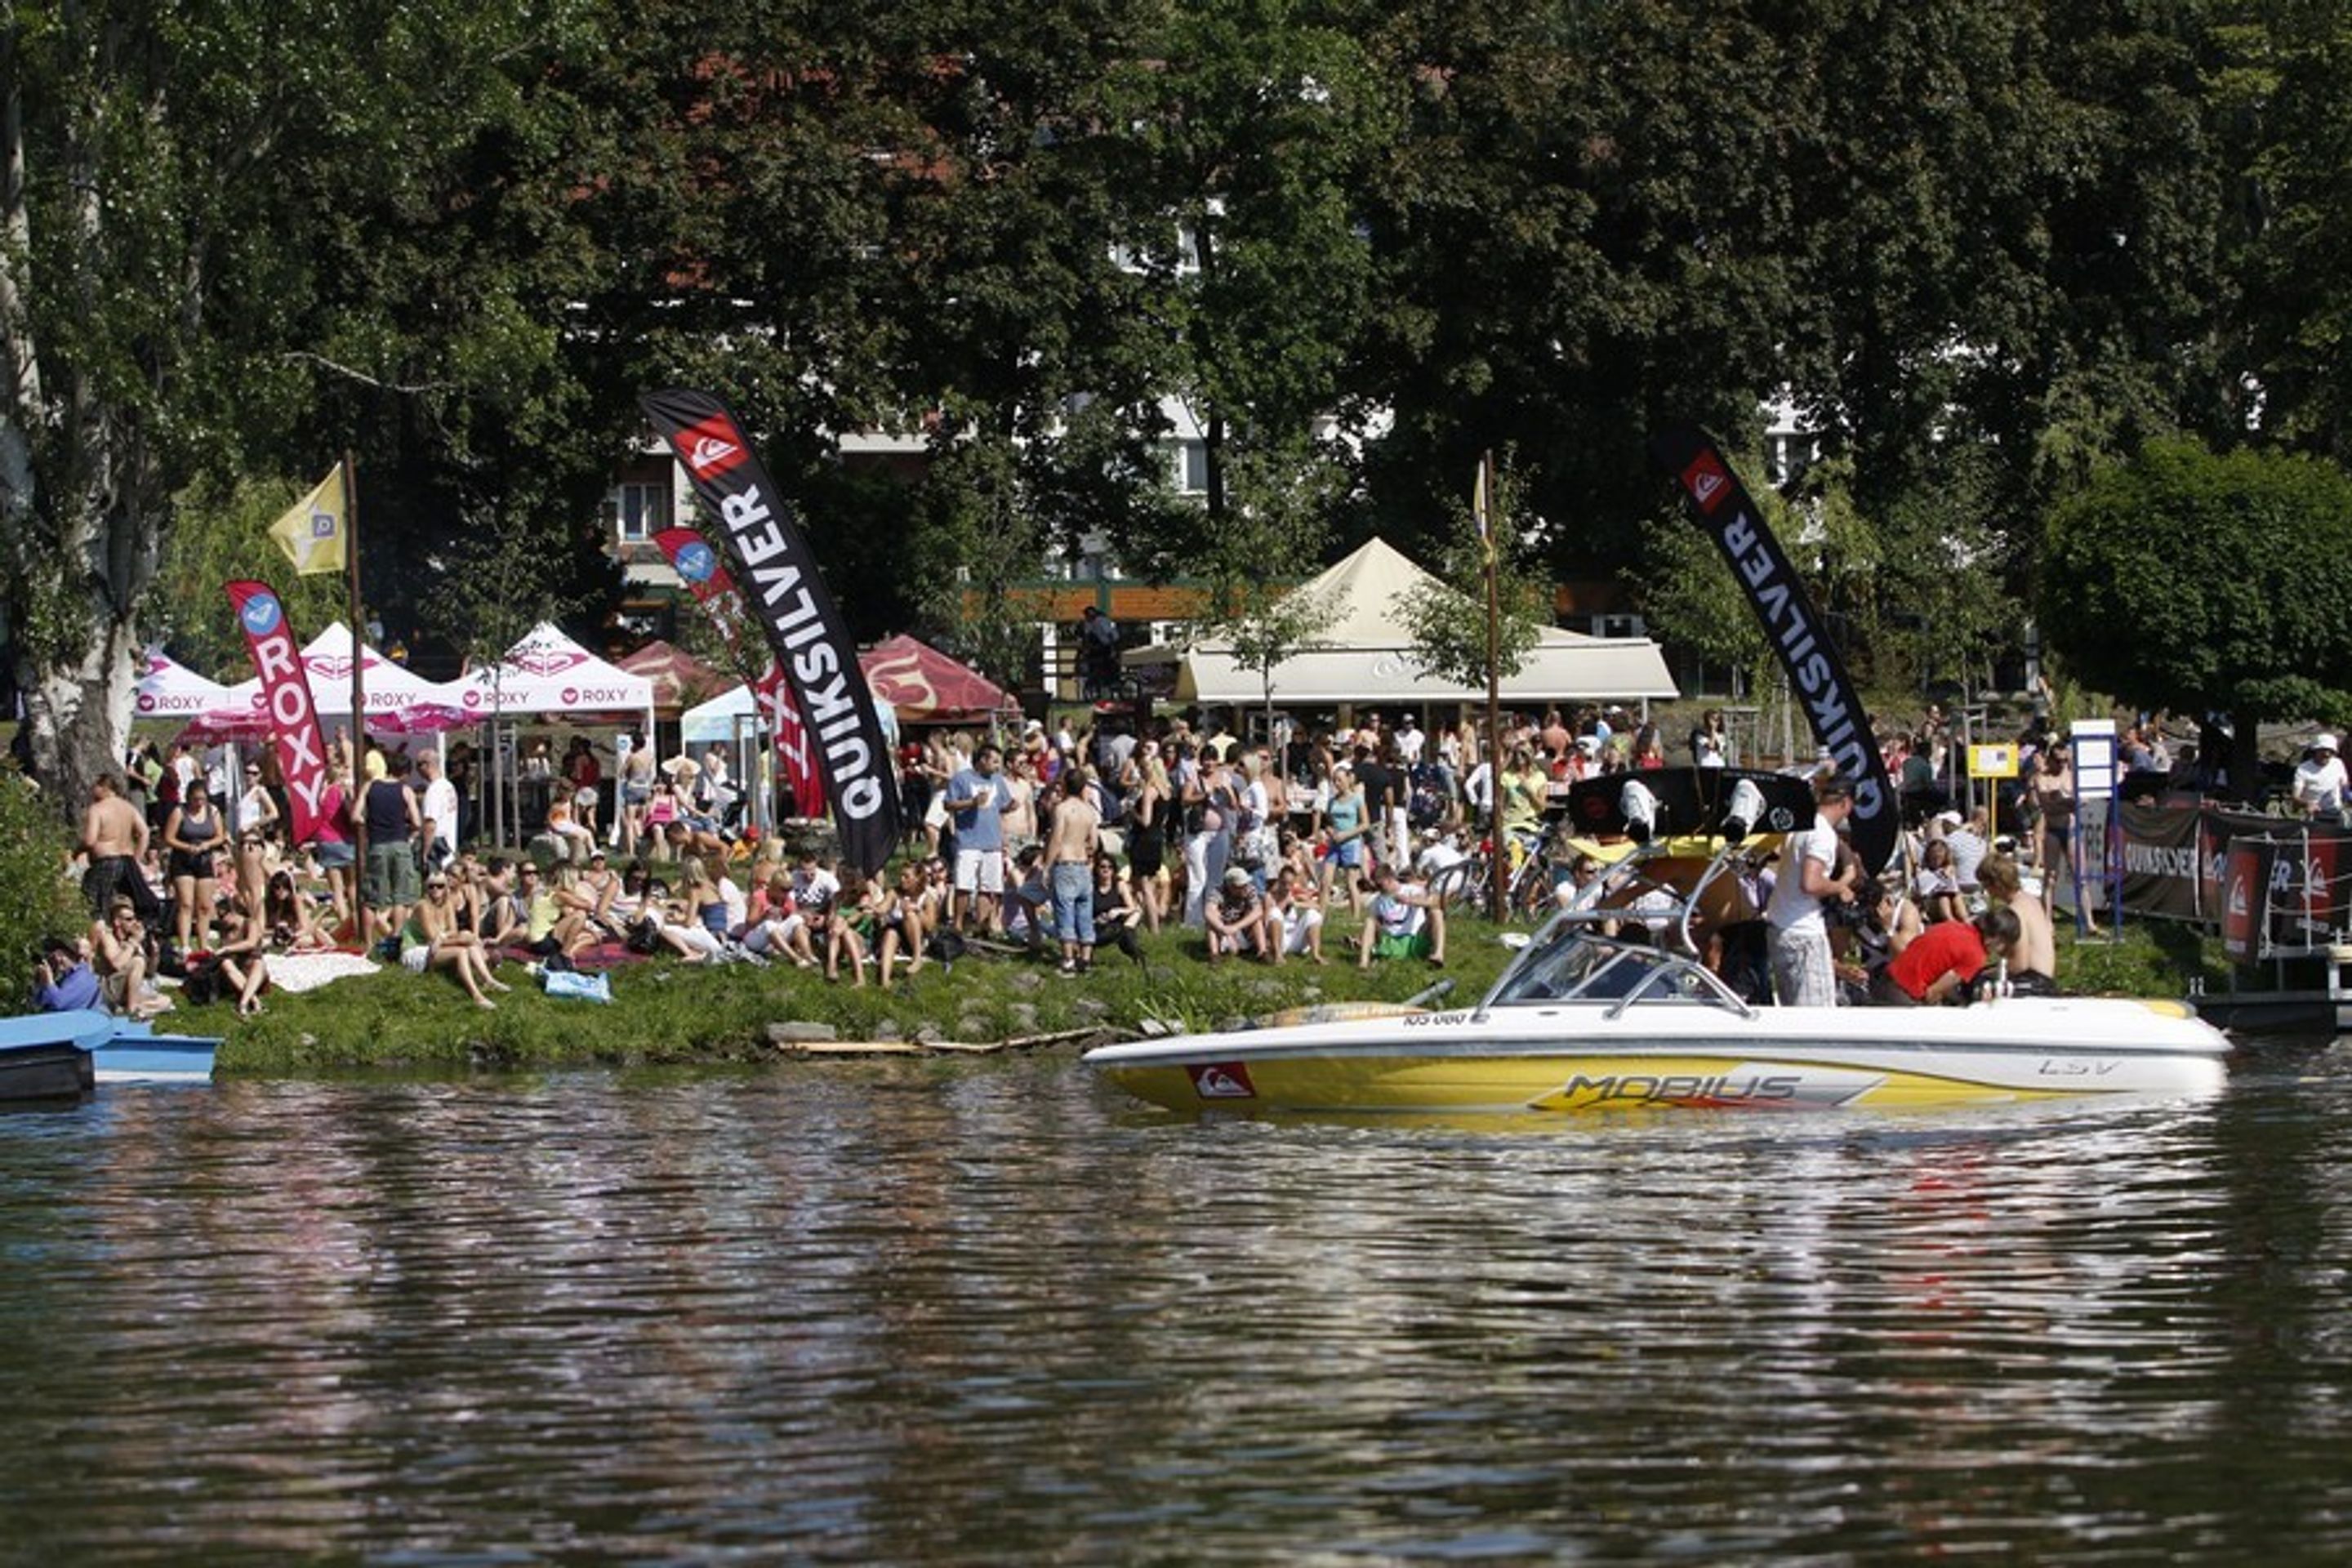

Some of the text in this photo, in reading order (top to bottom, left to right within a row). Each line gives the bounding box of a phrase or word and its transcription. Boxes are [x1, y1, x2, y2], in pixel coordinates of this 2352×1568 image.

[720, 484, 884, 819] QUIKSILVER
[1724, 511, 1882, 819] QUIKSILVER
[158, 695, 203, 710] ROXY
[371, 693, 416, 707] ROXY
[484, 692, 529, 706] ROXY
[582, 688, 627, 702] ROXY
[254, 635, 326, 817] ROXY
[1563, 1076, 1802, 1100] MOBIUS
